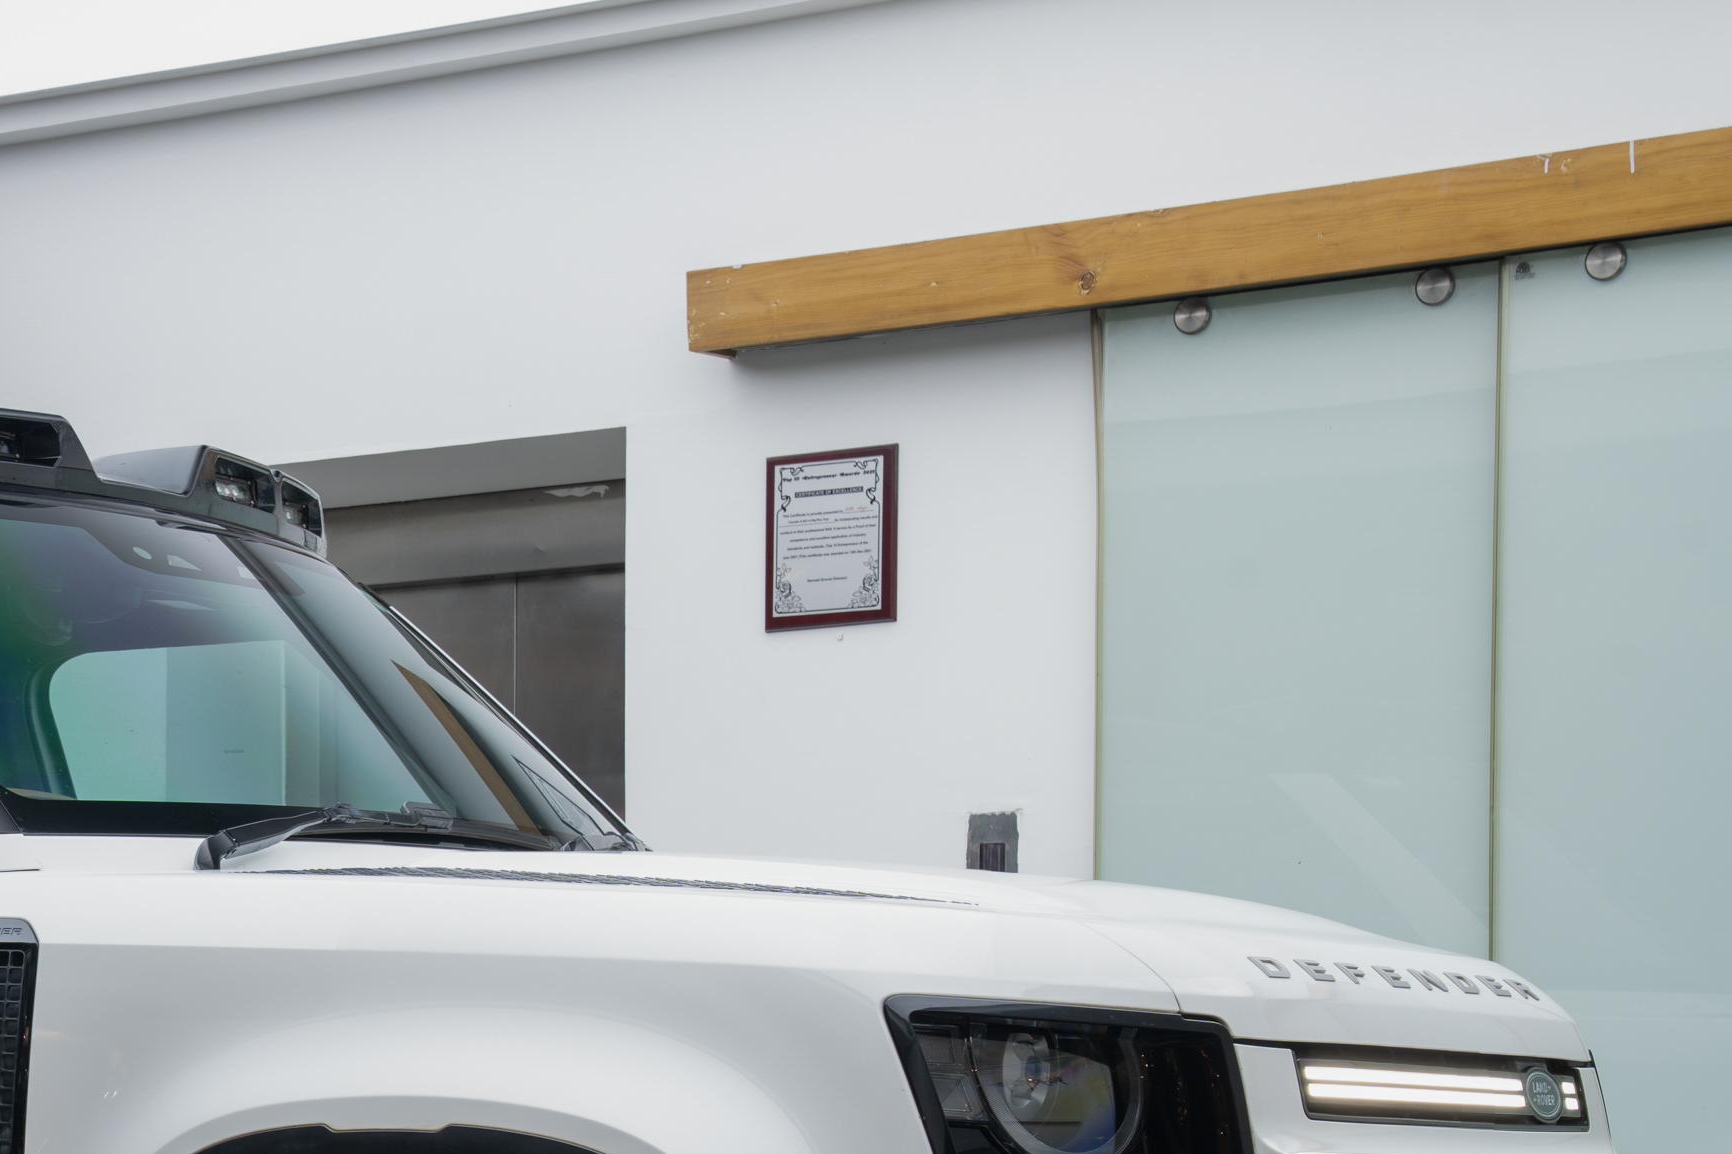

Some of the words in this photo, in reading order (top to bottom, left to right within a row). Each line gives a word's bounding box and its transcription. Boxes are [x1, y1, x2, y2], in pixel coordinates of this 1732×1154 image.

[1247, 956, 1540, 1001] DEFENDER
[1532, 1082, 1548, 1093] LAND
[1536, 1094, 1556, 1106] ROVER
